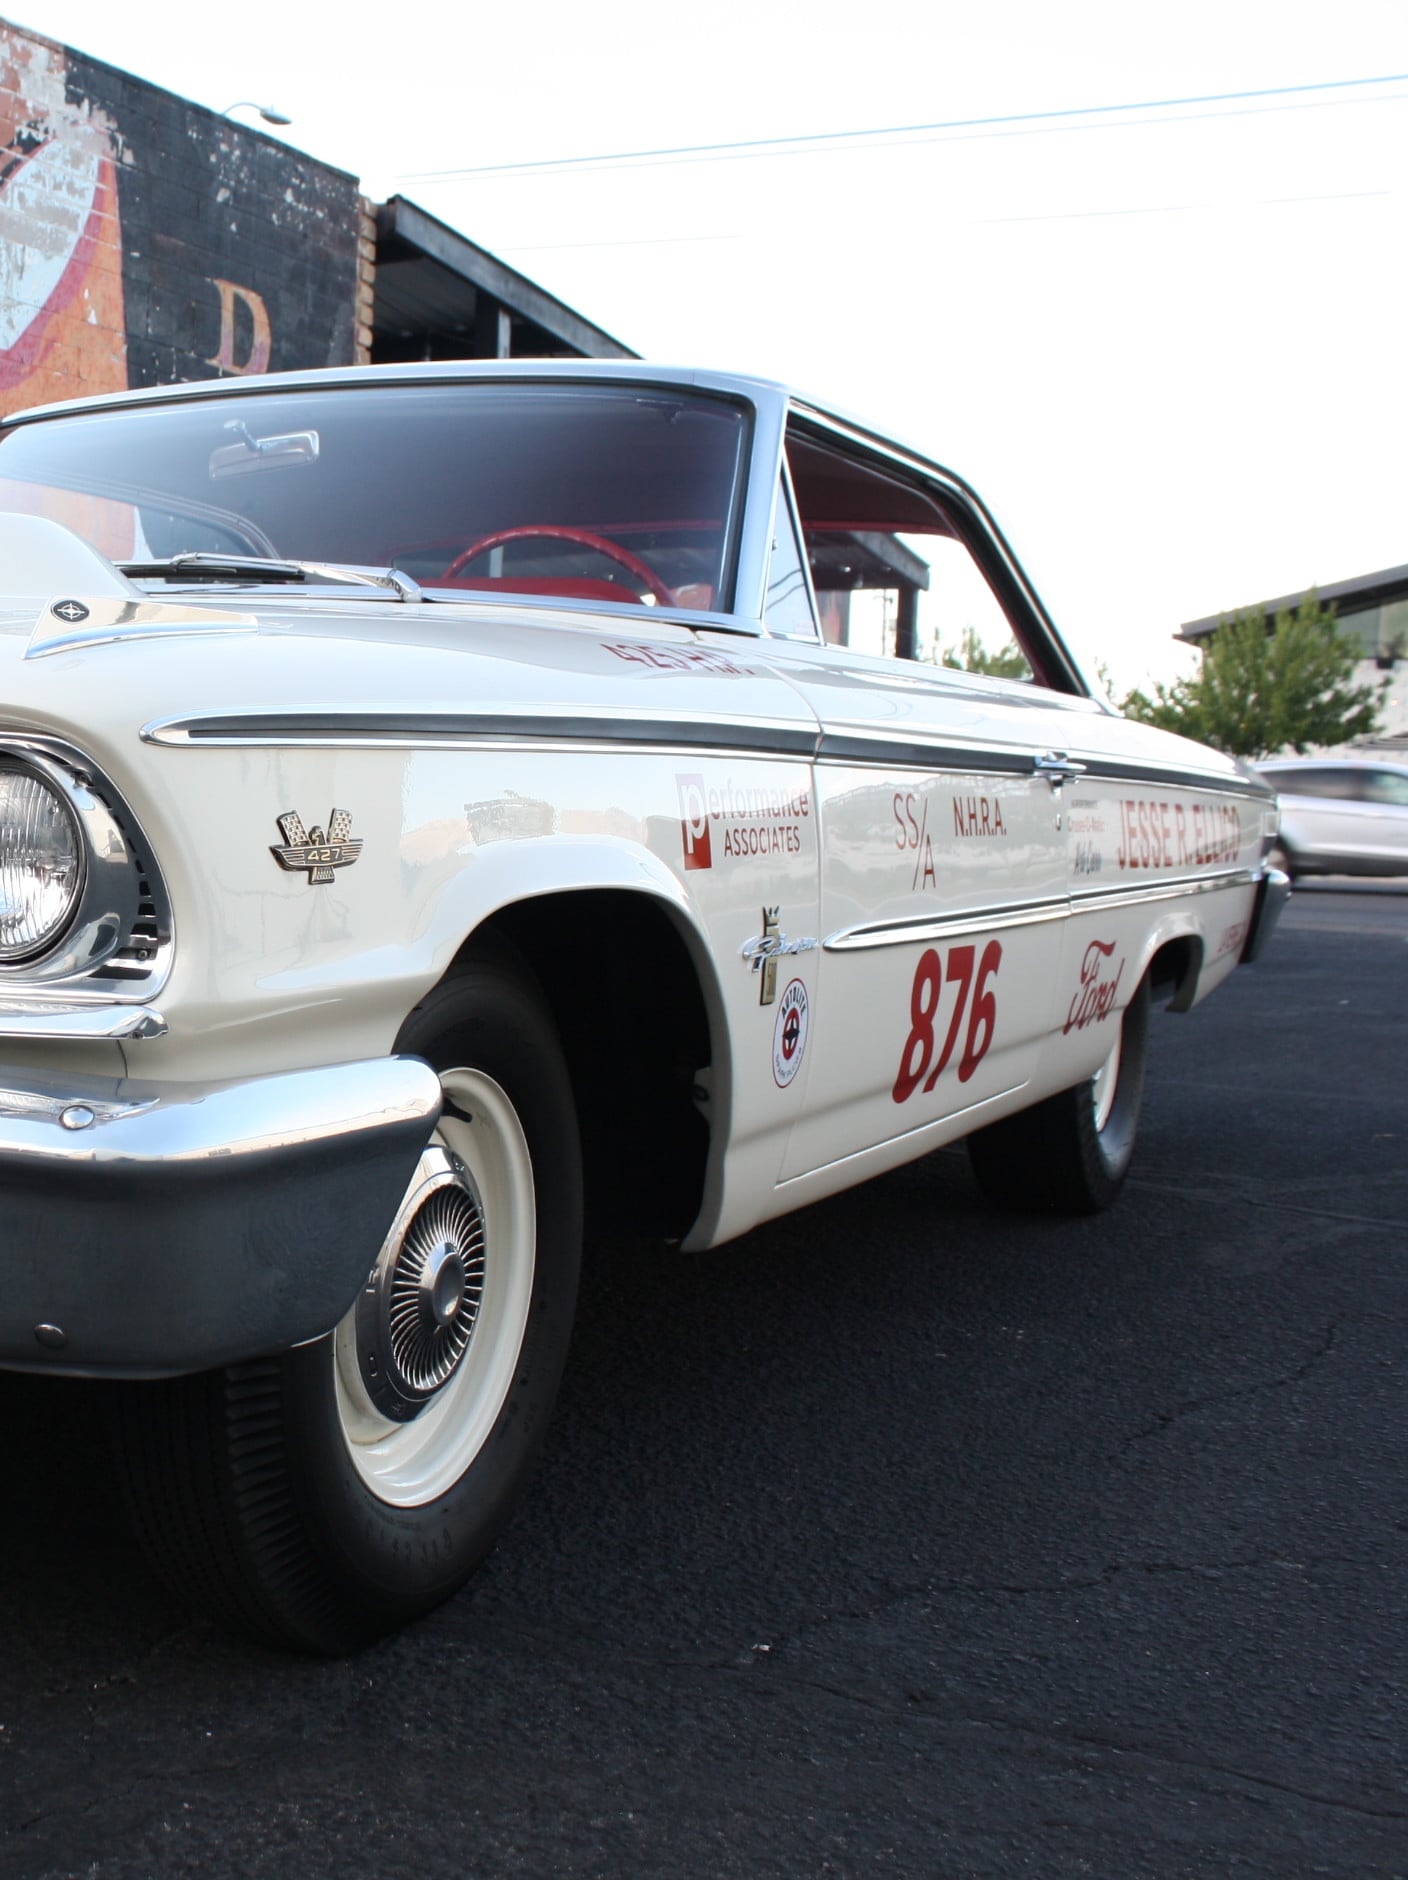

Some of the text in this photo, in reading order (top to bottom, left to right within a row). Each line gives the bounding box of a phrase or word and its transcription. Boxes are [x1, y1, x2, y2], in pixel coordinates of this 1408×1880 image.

[205, 277, 273, 375] D
[600, 643, 692, 670] 425
[307, 848, 342, 862] 427
[724, 825, 801, 857] ASSOCIATES
[1118, 800, 1173, 870] JESSE
[891, 938, 1004, 1105] 876
[1062, 939, 1126, 1036] Ford
